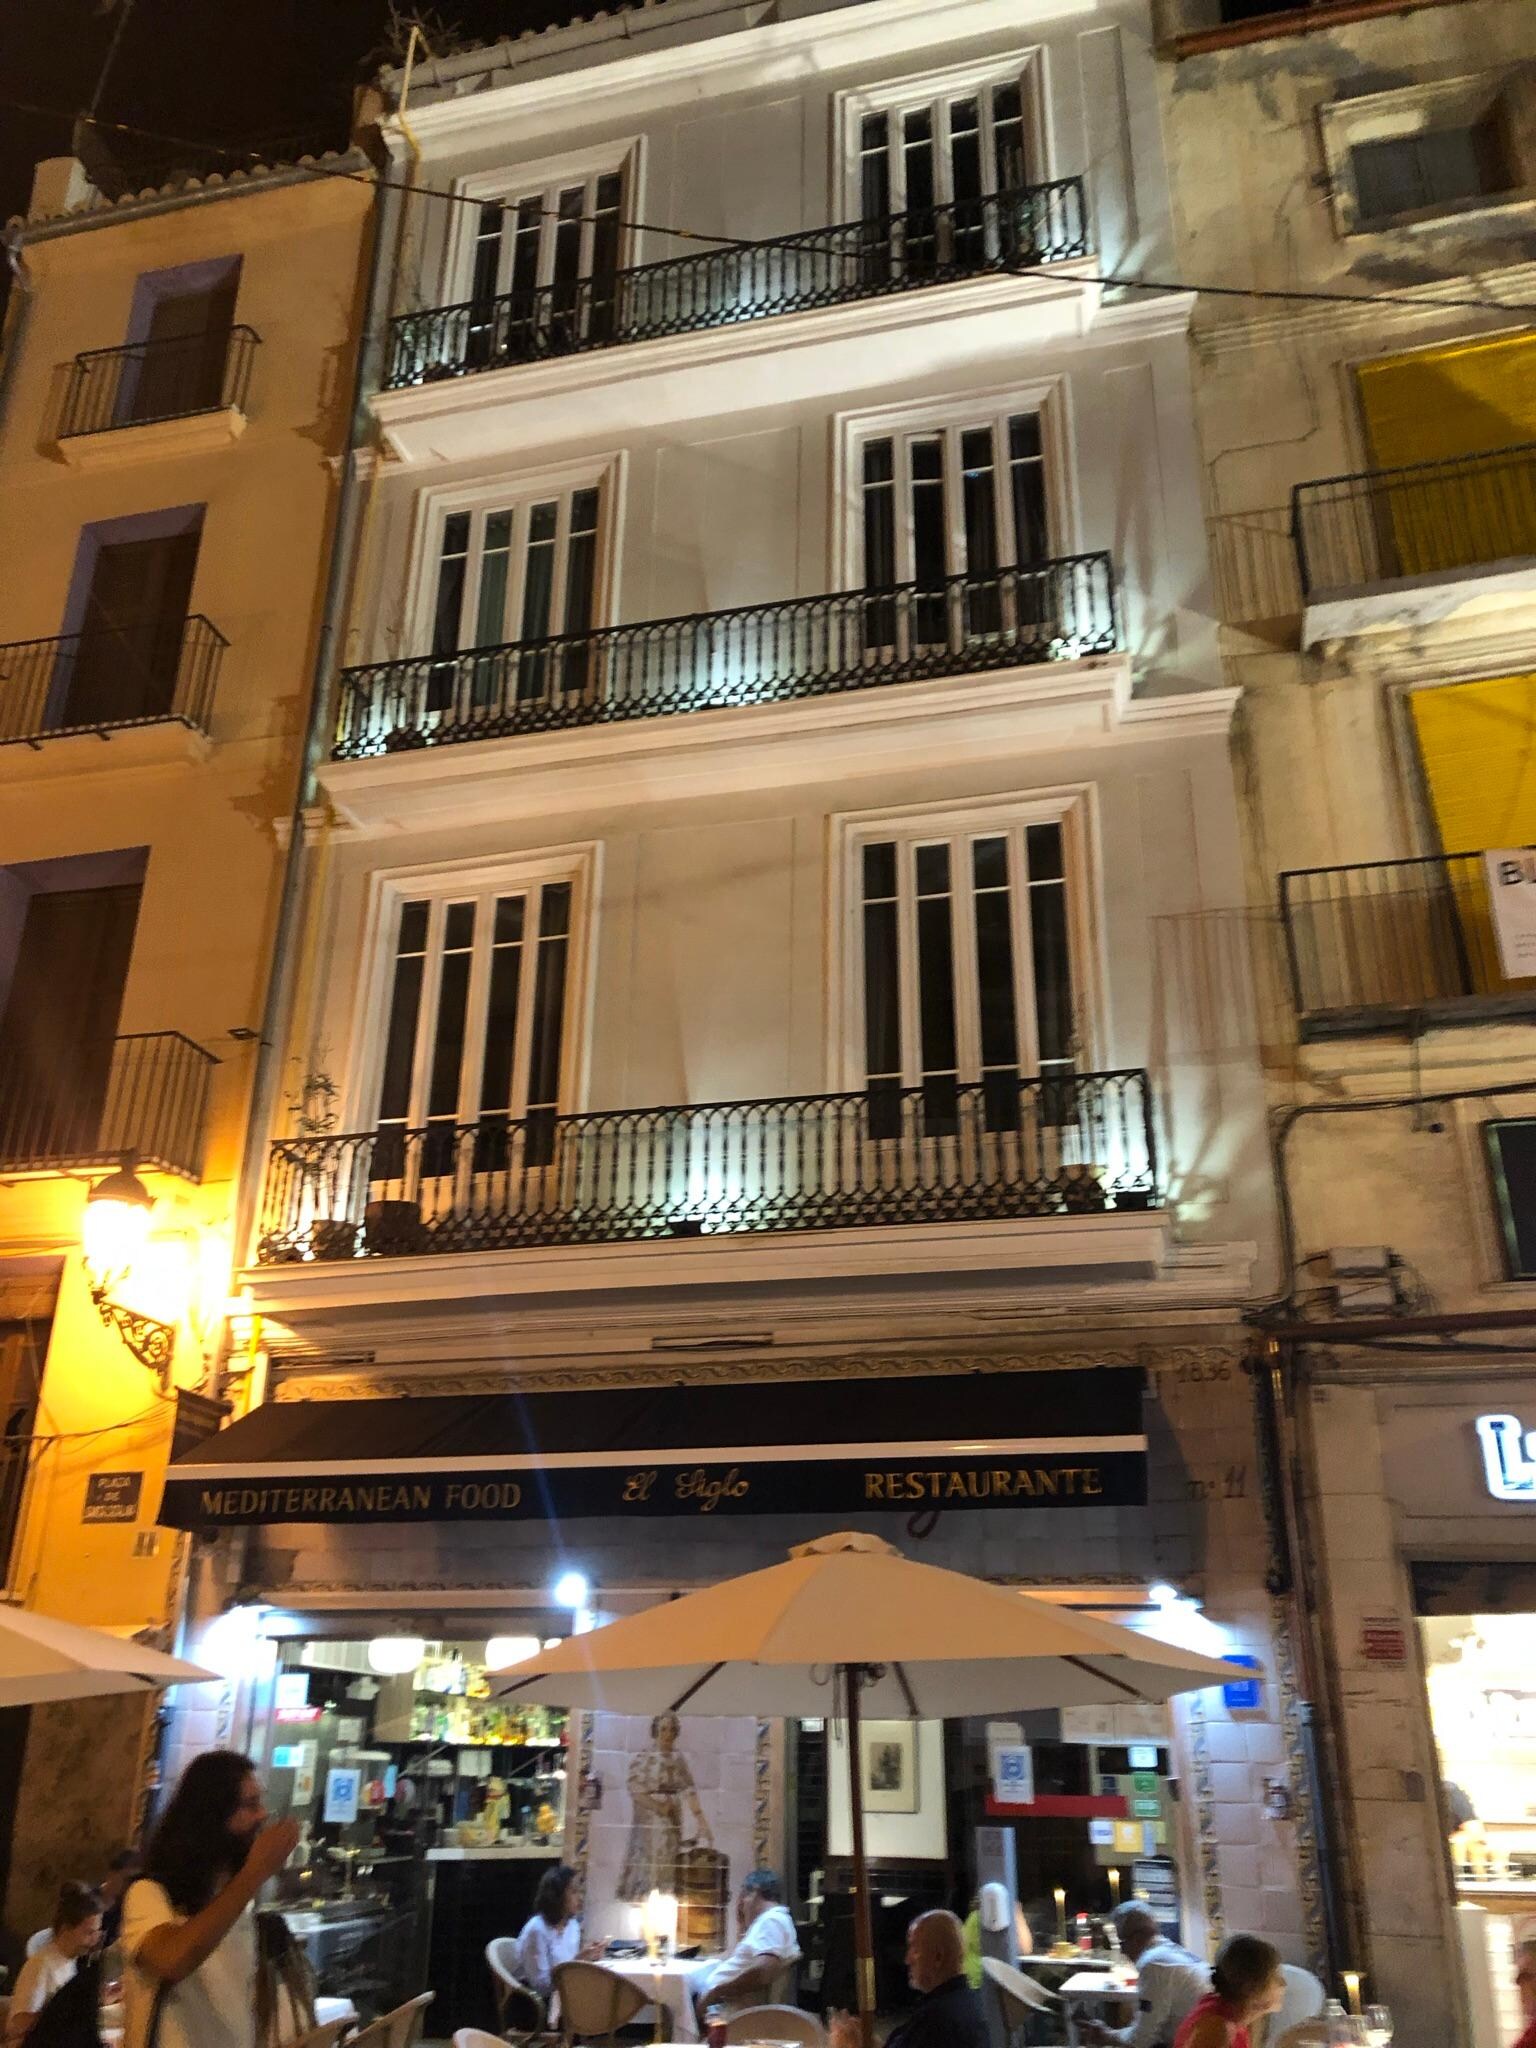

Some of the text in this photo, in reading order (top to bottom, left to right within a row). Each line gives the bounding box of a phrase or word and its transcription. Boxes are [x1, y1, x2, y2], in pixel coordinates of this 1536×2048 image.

[202, 1468, 1103, 1515] MEDITERRANEAN FOOD El Siglo RESTAURANTE
